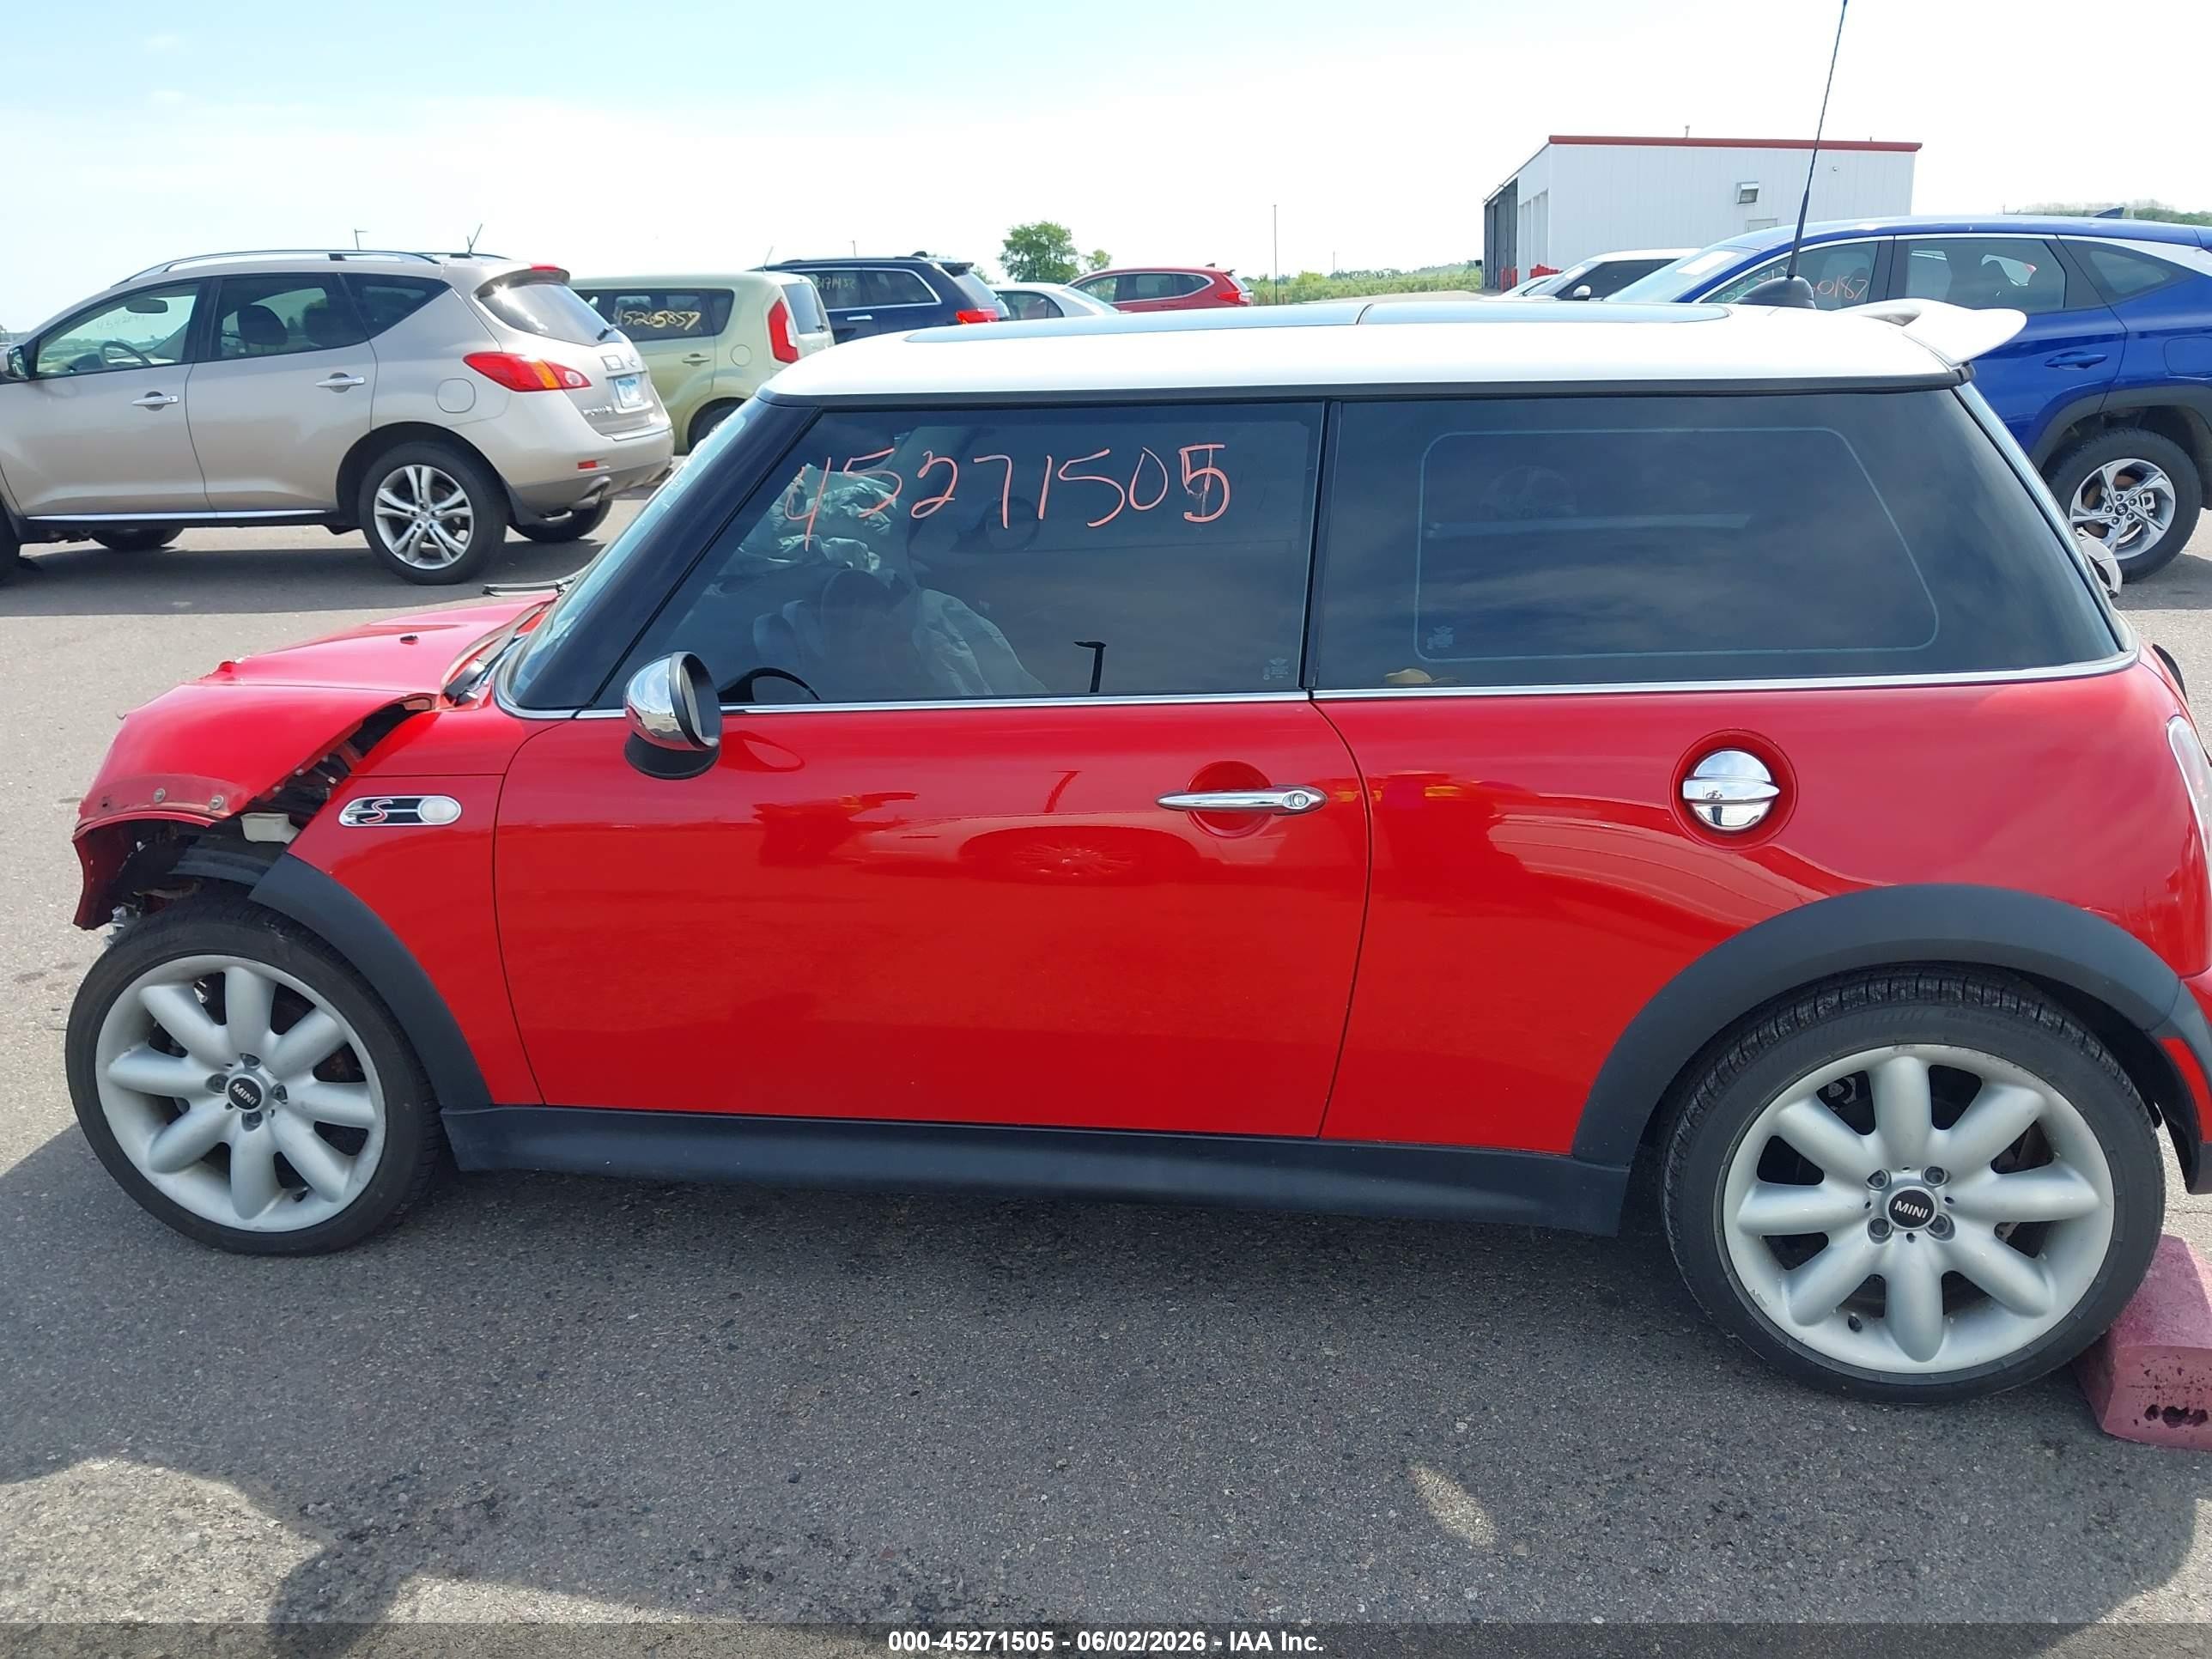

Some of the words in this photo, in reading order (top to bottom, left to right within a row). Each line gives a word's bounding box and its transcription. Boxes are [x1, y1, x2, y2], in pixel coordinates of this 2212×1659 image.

[783, 443, 1231, 553] 45271505
[361, 799, 394, 824] S
[232, 1083, 258, 1105] MINI
[1894, 1200, 1929, 1218] MINI
